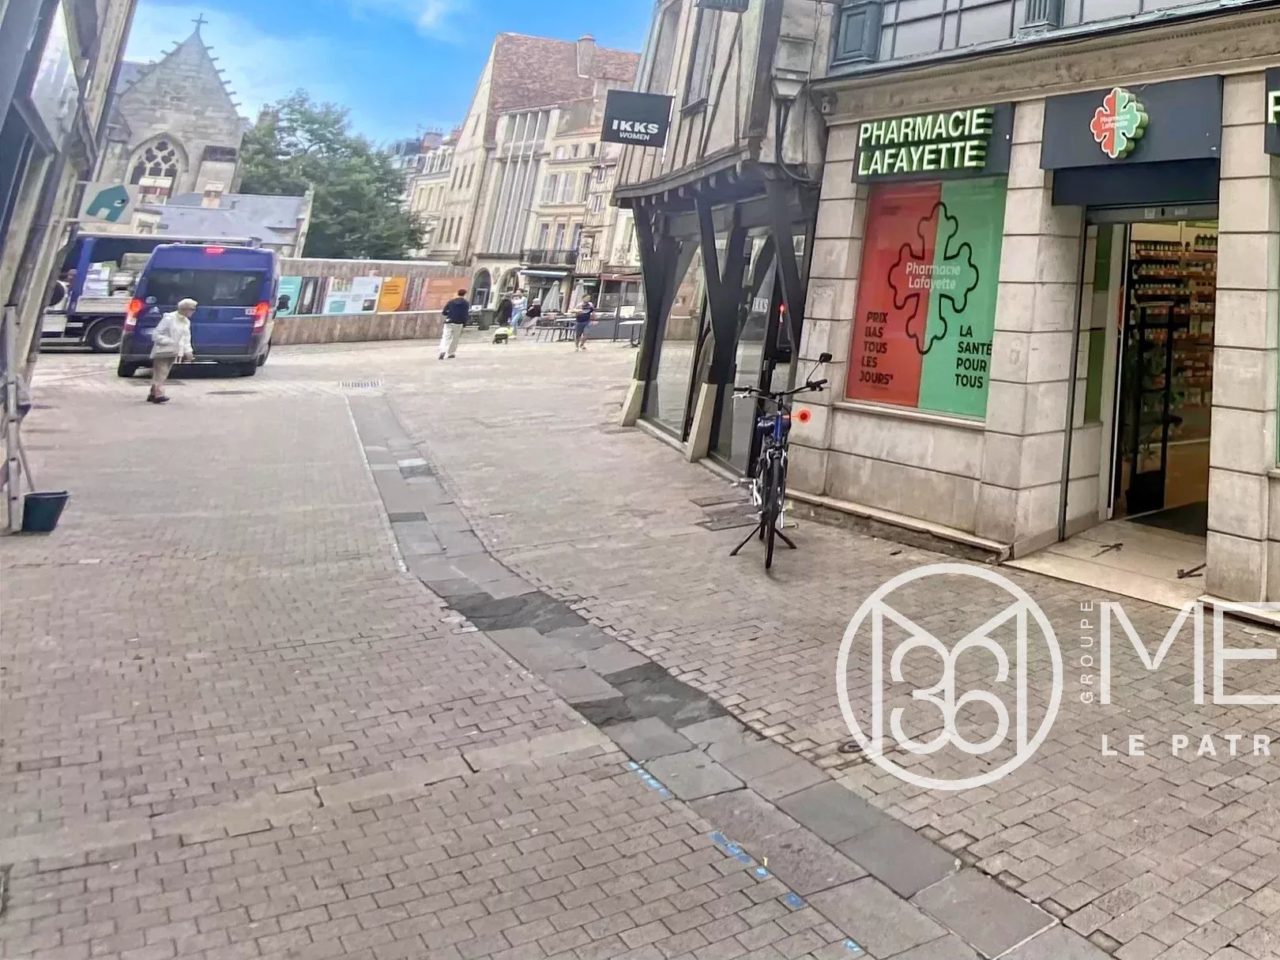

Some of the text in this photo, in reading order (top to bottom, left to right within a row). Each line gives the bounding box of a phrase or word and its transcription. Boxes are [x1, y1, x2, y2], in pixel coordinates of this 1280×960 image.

[611, 119, 660, 134] IKKS
[858, 107, 990, 147] PHARMACIE
[619, 131, 651, 141] WOMEN
[857, 140, 985, 176] LAFAYETTE
[905, 262, 961, 276] Pharmacie
[908, 276, 957, 292] Lafayette
[866, 311, 889, 324] PRIX
[959, 325, 973, 338] LA
[863, 341, 888, 354] TOUS
[861, 355, 878, 368] LES
[956, 357, 988, 373] POUR
[955, 373, 984, 389] TOUS
